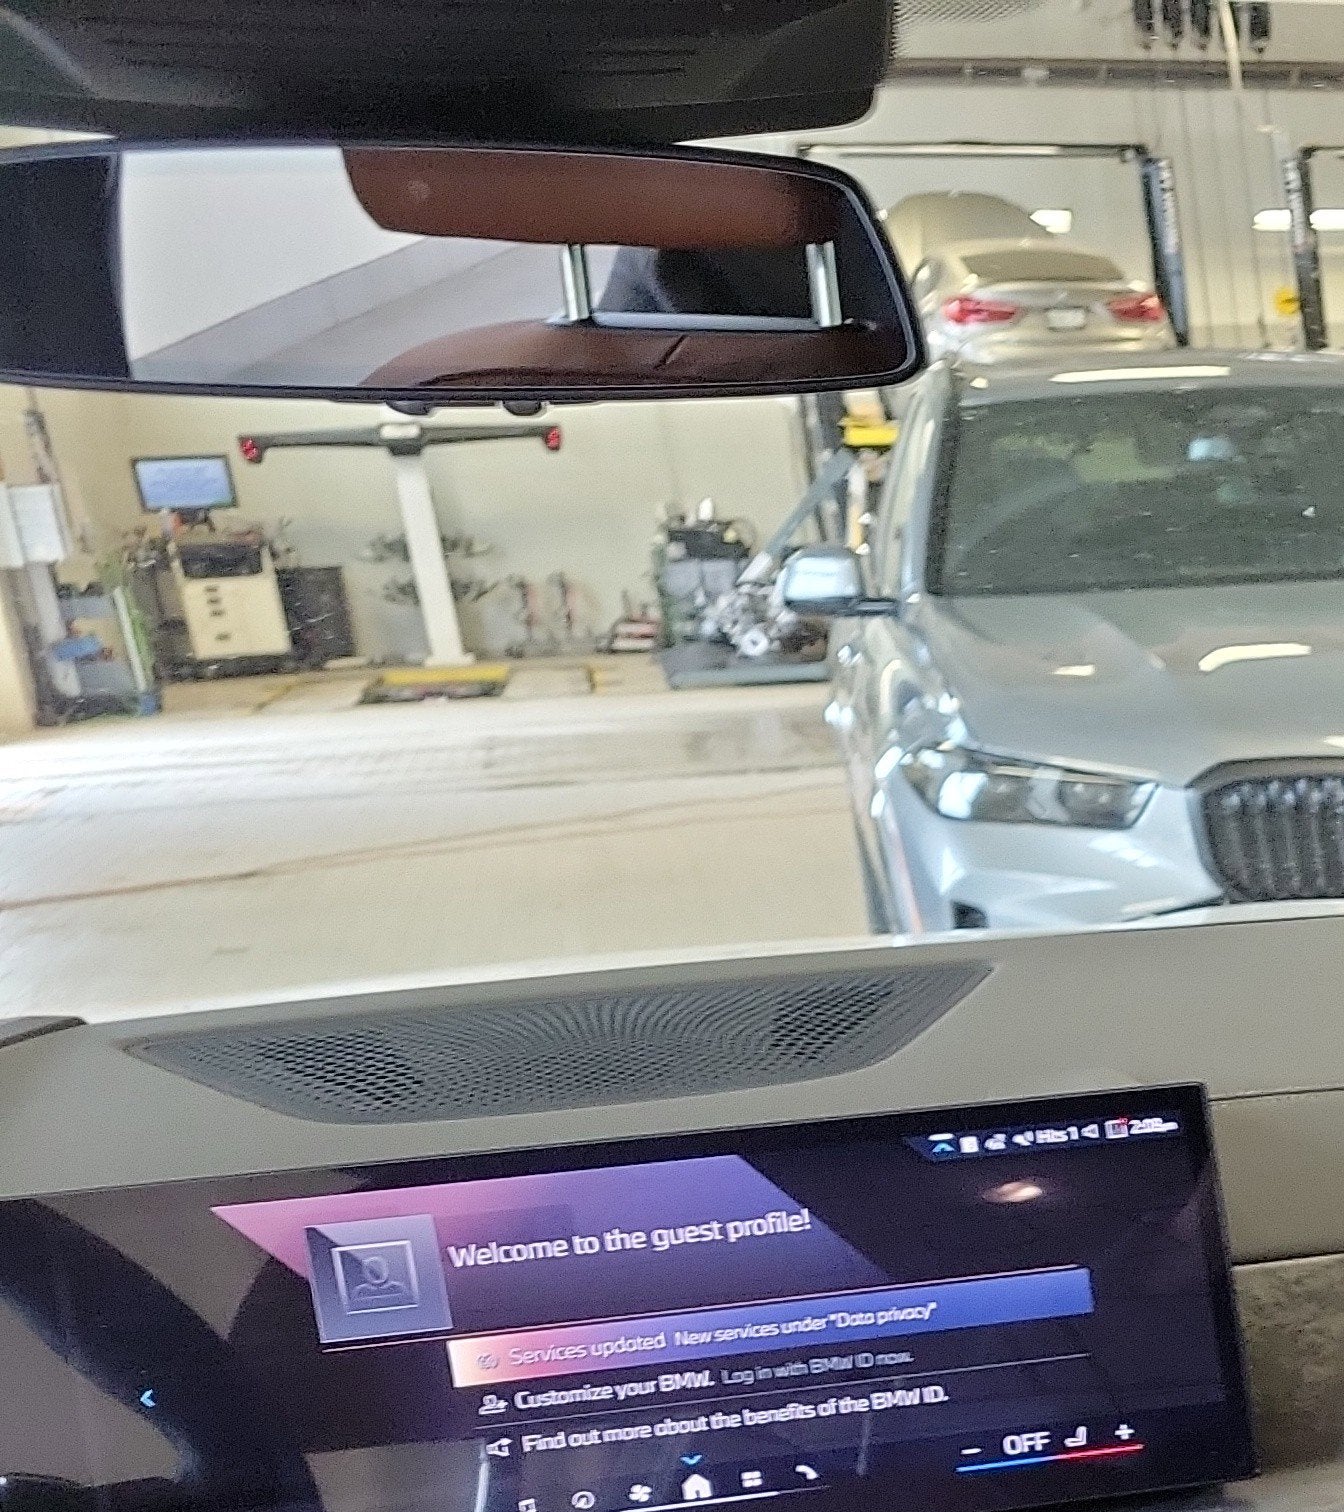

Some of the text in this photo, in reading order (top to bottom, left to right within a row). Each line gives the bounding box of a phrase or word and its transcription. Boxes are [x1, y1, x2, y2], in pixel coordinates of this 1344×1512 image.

[449, 1208, 812, 1267] Welcome to the guest profile!
[509, 1332, 666, 1365] Services updated
[674, 1329, 713, 1347] New
[713, 1322, 780, 1344] services
[780, 1317, 828, 1335] under
[514, 1369, 716, 1409] Customize your BMW.
[721, 1368, 755, 1385] Log
[756, 1364, 773, 1380] in
[774, 1361, 810, 1378] with
[521, 1431, 567, 1453] Find
[567, 1428, 601, 1447] out
[602, 1424, 653, 1444] more
[653, 1416, 709, 1437] about
[709, 1410, 743, 1430] the
[742, 1402, 817, 1427] benefits
[816, 1397, 838, 1417] of
[837, 1395, 870, 1414] the
[869, 1387, 921, 1410] BMW
[1002, 1431, 1051, 1456] OFF
